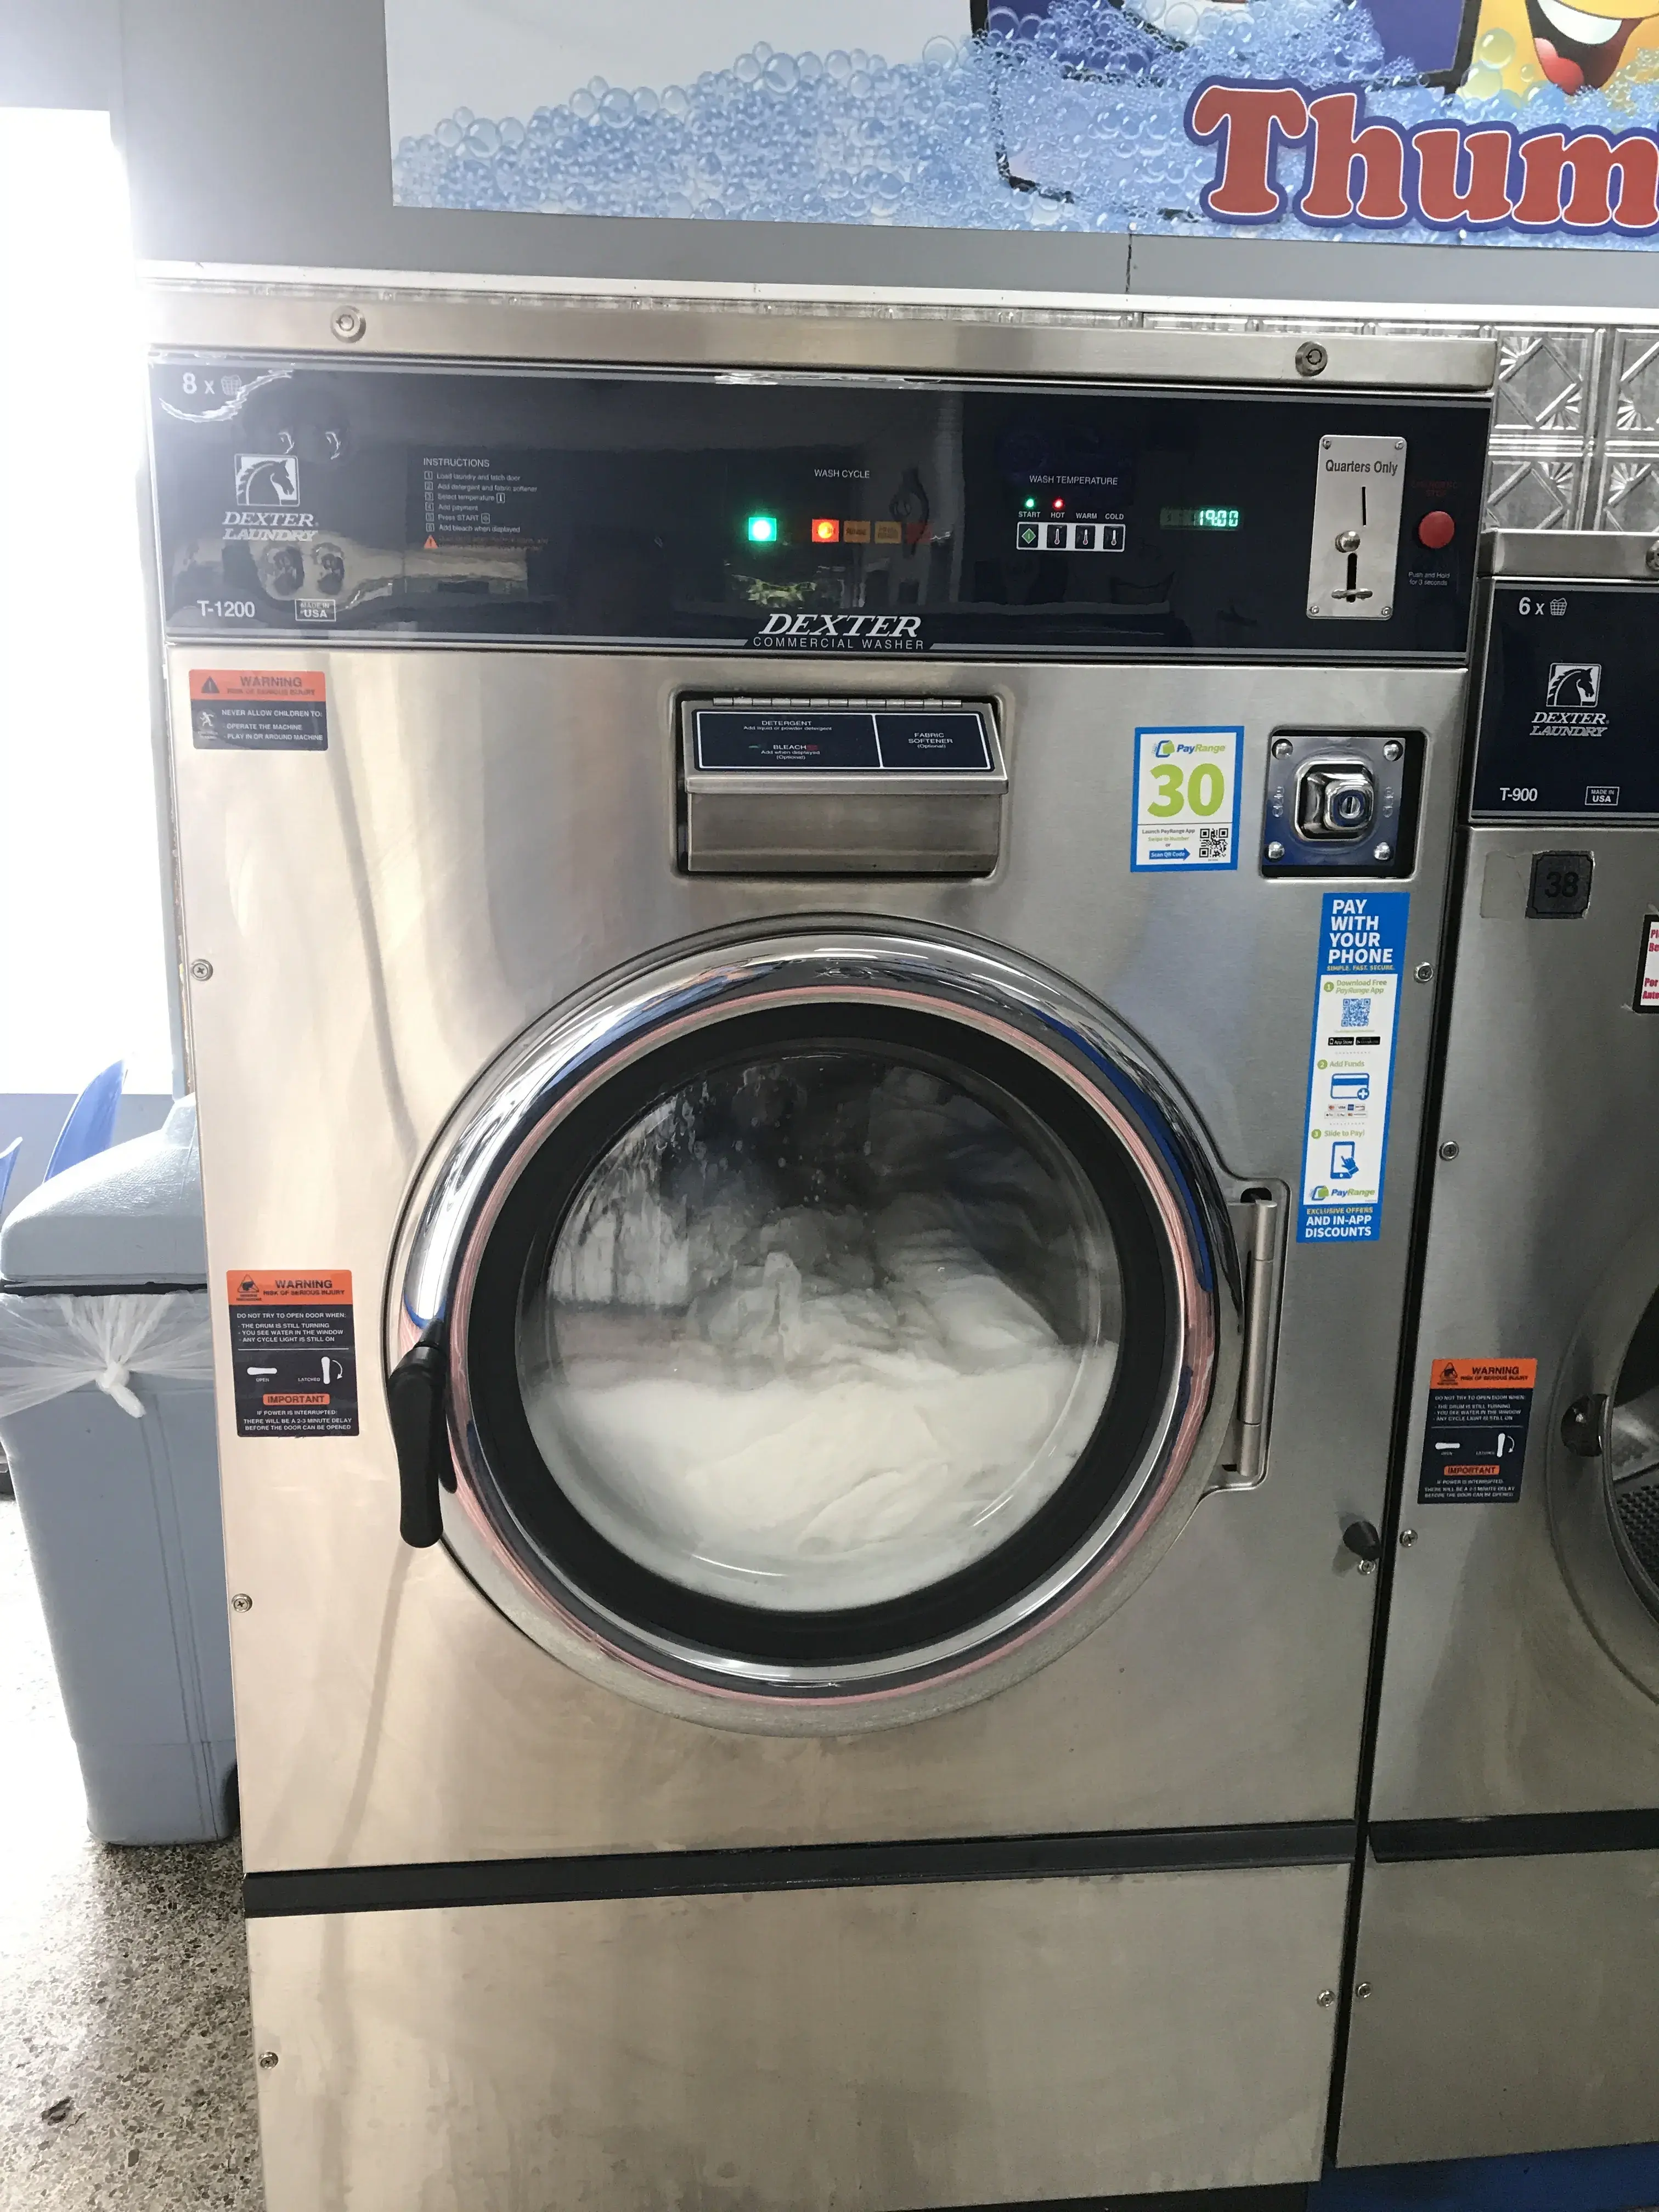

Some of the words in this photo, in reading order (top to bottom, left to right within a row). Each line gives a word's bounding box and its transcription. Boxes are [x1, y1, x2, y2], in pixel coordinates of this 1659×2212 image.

[1191, 83, 1659, 229] Thum
[183, 373, 197, 394] 8
[424, 458, 489, 467] INSTRUCTIONS
[1326, 460, 1370, 473] Quarters
[1374, 461, 1398, 476] Only
[814, 469, 839, 477] WASH
[842, 470, 870, 478] CYCLE
[1057, 476, 1118, 485] TEMPERATURE
[222, 511, 314, 527] DEXTER
[223, 528, 318, 541] LAUNDRY
[197, 600, 255, 617] T-1200
[1519, 597, 1531, 615] 6
[759, 613, 922, 637] DEXTER
[753, 637, 854, 648] COMMERCIAL
[862, 639, 924, 650] WASHER
[240, 676, 302, 686] WARNING
[1532, 712, 1606, 724] DEXTER
[1530, 726, 1607, 737] LAUNDRY
[1177, 744, 1225, 754] PayRange
[1148, 763, 1224, 817] 30
[1500, 788, 1538, 802] T-900
[1544, 871, 1579, 898] 38
[1333, 899, 1367, 914] PAY
[1331, 916, 1379, 930] WITH
[1329, 932, 1380, 947] YOUR
[1329, 949, 1393, 963] PHONE
[1331, 1188, 1375, 1198] PayRange
[1306, 1216, 1330, 1226] AND
[1333, 1215, 1372, 1224] IN-APP
[1306, 1227, 1371, 1238] DISCOUNTS
[275, 1280, 332, 1289] WARNING
